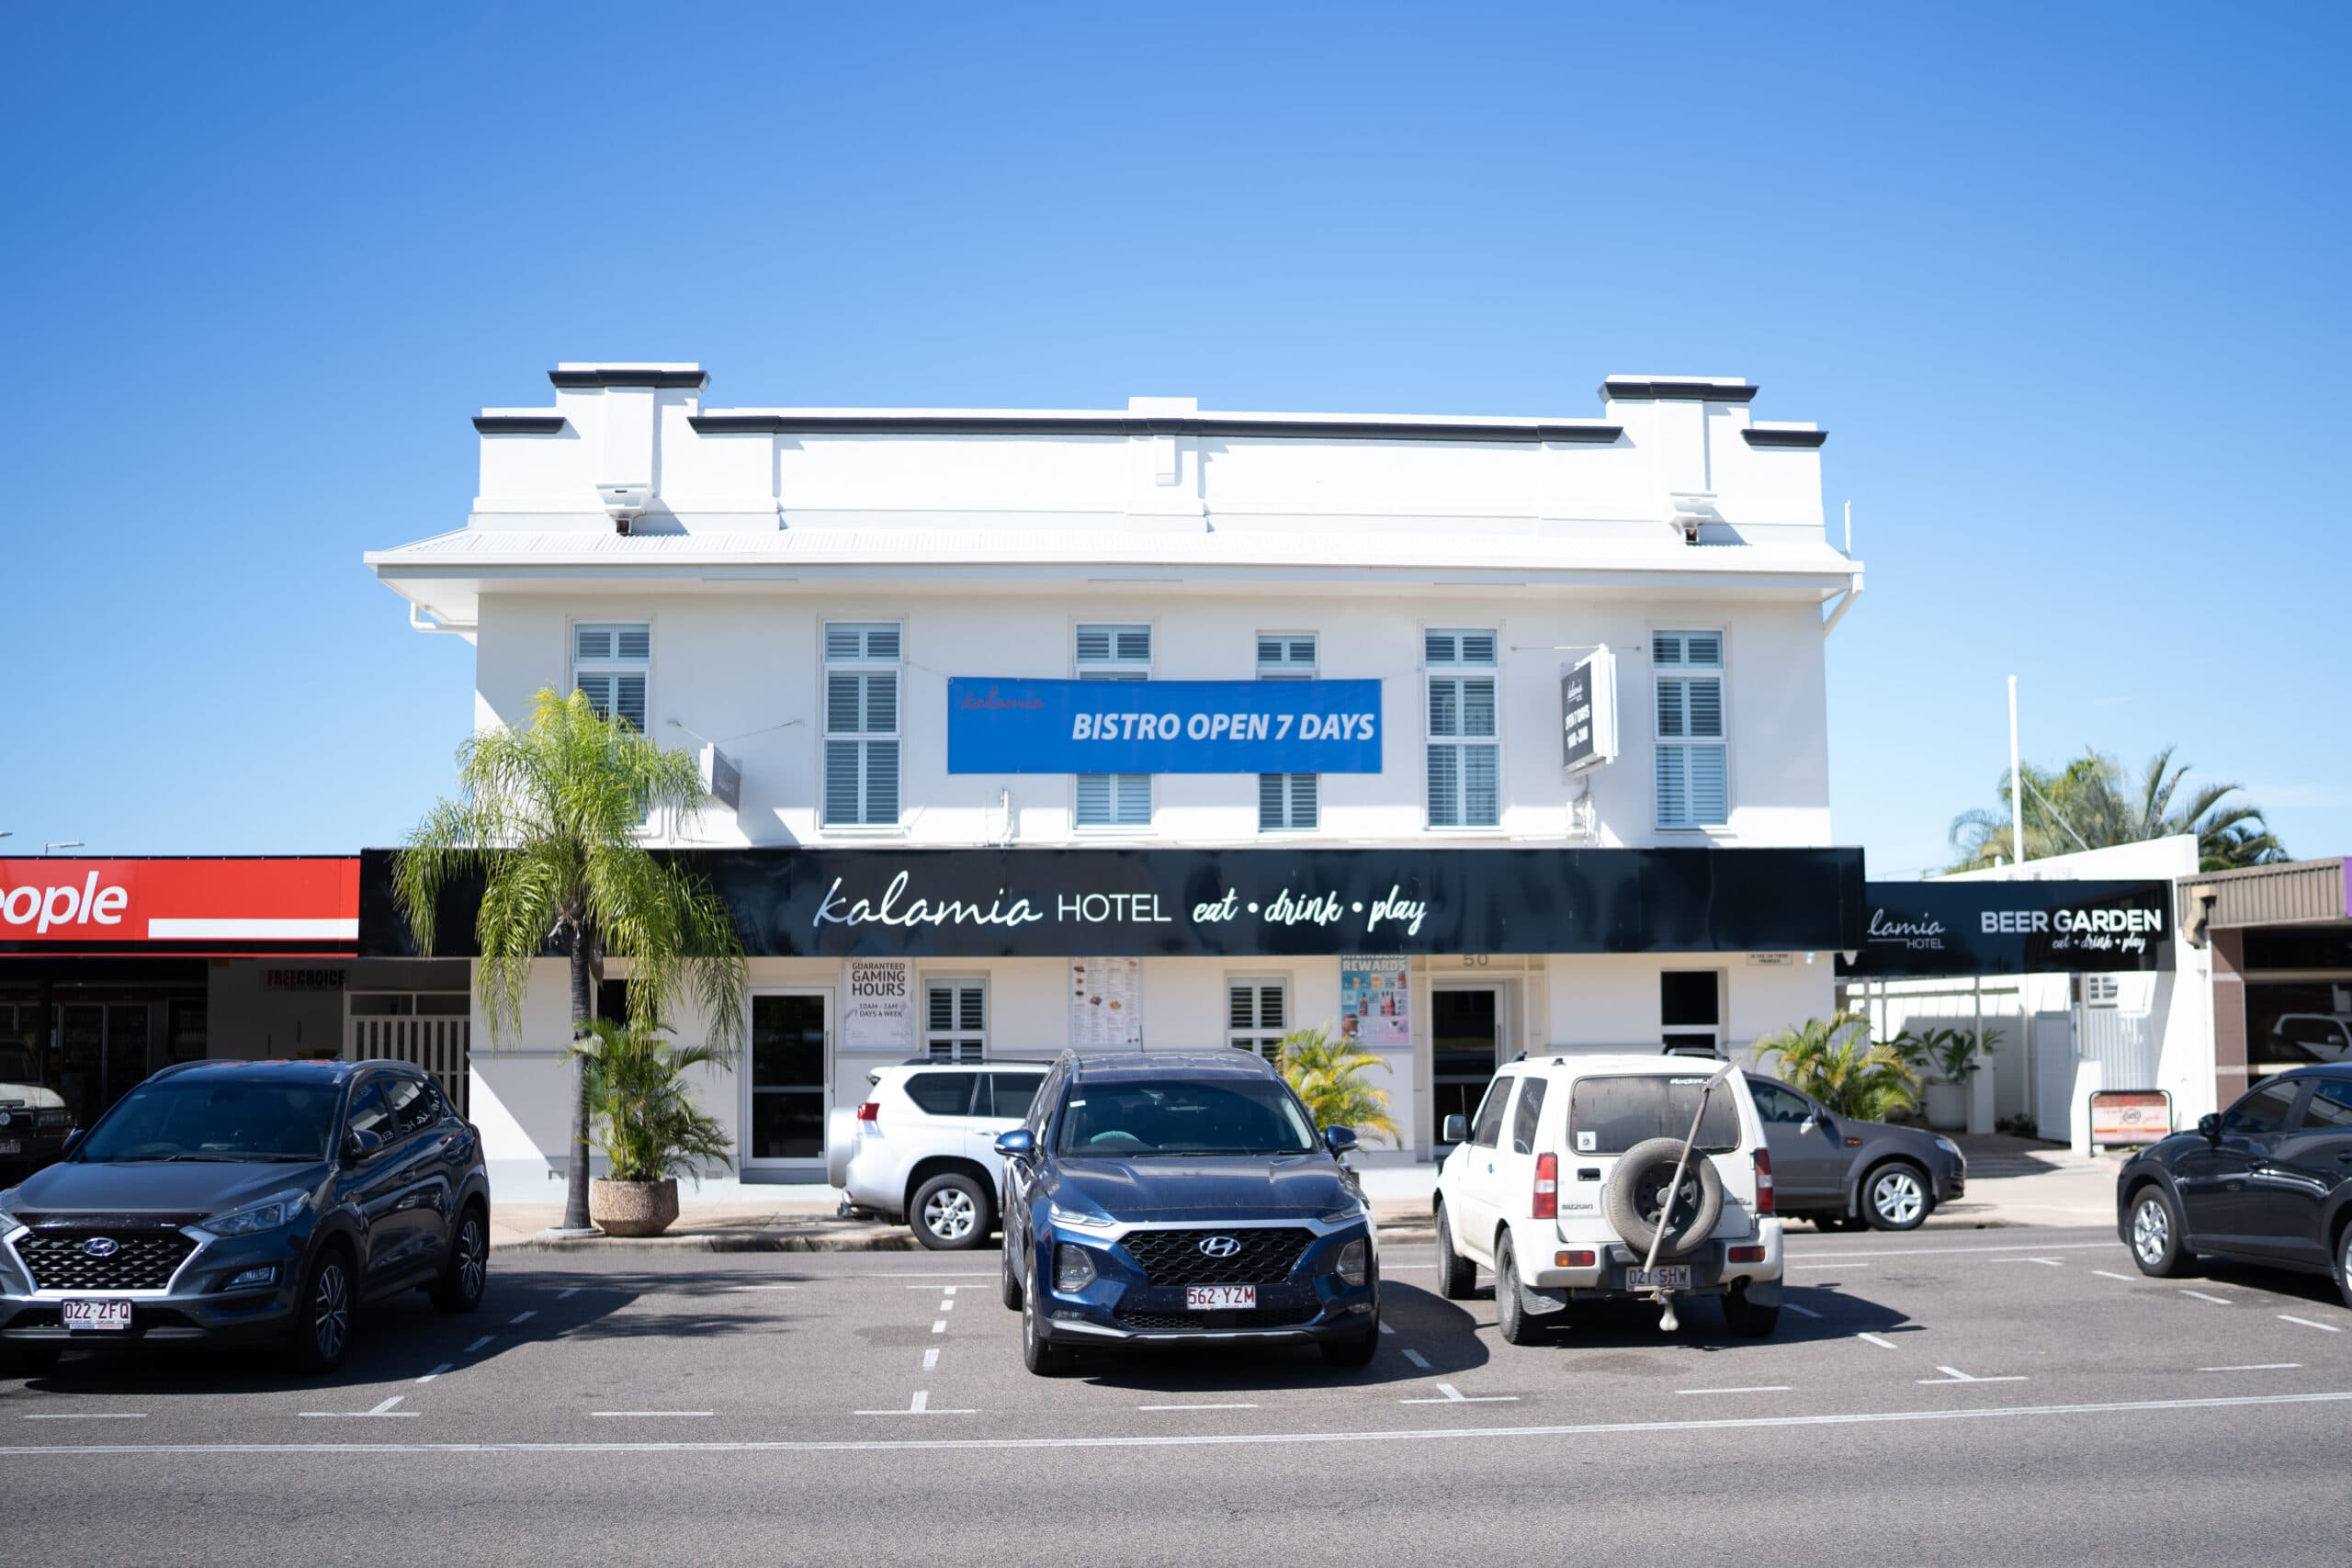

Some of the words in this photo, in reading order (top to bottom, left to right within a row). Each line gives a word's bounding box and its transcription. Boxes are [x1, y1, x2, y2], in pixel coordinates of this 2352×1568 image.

[961, 688, 1046, 710] kalamia
[1072, 713, 1181, 740] BISTRO
[1187, 713, 1270, 740] OPEN
[1275, 713, 1293, 740] 7
[1298, 713, 1375, 740] DAYS
[0, 870, 129, 934] ople
[812, 869, 1044, 928] kalamia
[1057, 893, 1172, 922] HOTEL
[1193, 887, 1238, 923] eat
[1264, 887, 1344, 927] drink
[1367, 884, 1427, 937] play
[1867, 908, 1946, 937] lamia
[1981, 910, 2049, 933] BEER
[2053, 908, 2162, 932] GARDEN
[1906, 937, 1946, 949] HOTEL
[2052, 933, 2070, 950] eat
[2080, 933, 2113, 951] drink
[2121, 931, 2146, 955] play
[852, 962, 906, 970] GUARANTEED
[1342, 960, 1406, 971] REWARDS
[1463, 954, 1489, 967] 50
[852, 970, 906, 982] GAMING
[852, 983, 906, 997] HOURS
